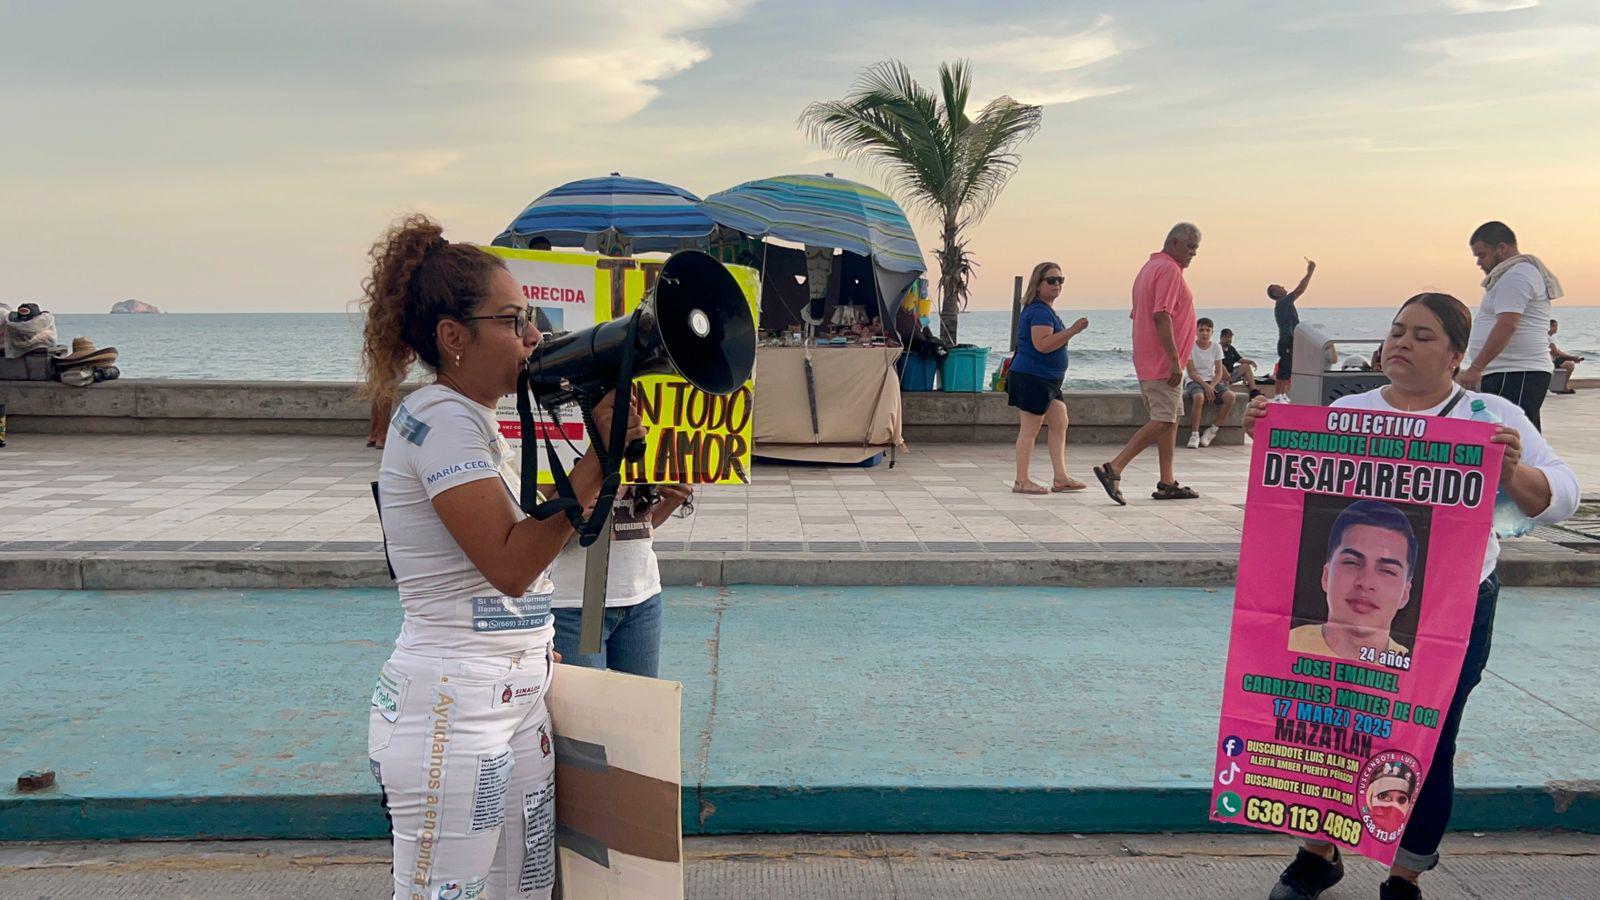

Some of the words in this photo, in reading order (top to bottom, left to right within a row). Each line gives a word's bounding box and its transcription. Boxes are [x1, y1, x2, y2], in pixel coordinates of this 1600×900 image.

[522, 285, 586, 304] ARECIDA
[666, 382, 753, 435] TODO
[1326, 411, 1427, 438] COLECTIVO
[654, 427, 750, 484] AMOR
[1269, 428, 1366, 457] BUSCANDOTE
[1368, 434, 1408, 459] LUIS
[1408, 440, 1450, 463] ALAN
[1454, 444, 1484, 467] SM
[1262, 452, 1485, 509] DESAPARECIDO
[1292, 657, 1331, 679] JOSE
[1335, 663, 1400, 694] EMANUEL
[1359, 646, 1377, 663] 24
[1379, 651, 1411, 670] años
[1243, 673, 1332, 705] CARRIZALES
[1335, 689, 1390, 716] MONTES
[1392, 700, 1412, 722] DE
[1413, 706, 1440, 730] OCA
[1273, 698, 1293, 718] 17
[1296, 702, 1350, 728] MARZO
[1354, 713, 1393, 740] 2025
[1246, 739, 1303, 761] BUSCANDOTE
[1304, 749, 1325, 765] LUIS
[1346, 759, 1361, 773] SM
[1275, 718, 1373, 757] MAZATLAN
[1249, 754, 1276, 768] ALERTA
[1275, 758, 1302, 773] AMBER
[1302, 763, 1328, 778] PUERTO
[1244, 772, 1300, 794] BUSCANDOTE
[1300, 781, 1321, 798] LUIS
[1341, 792, 1355, 807] SM
[1245, 796, 1286, 826] 638
[1289, 803, 1320, 833] 113
[1322, 810, 1363, 845] 4868
[1375, 829, 1388, 841] 113
